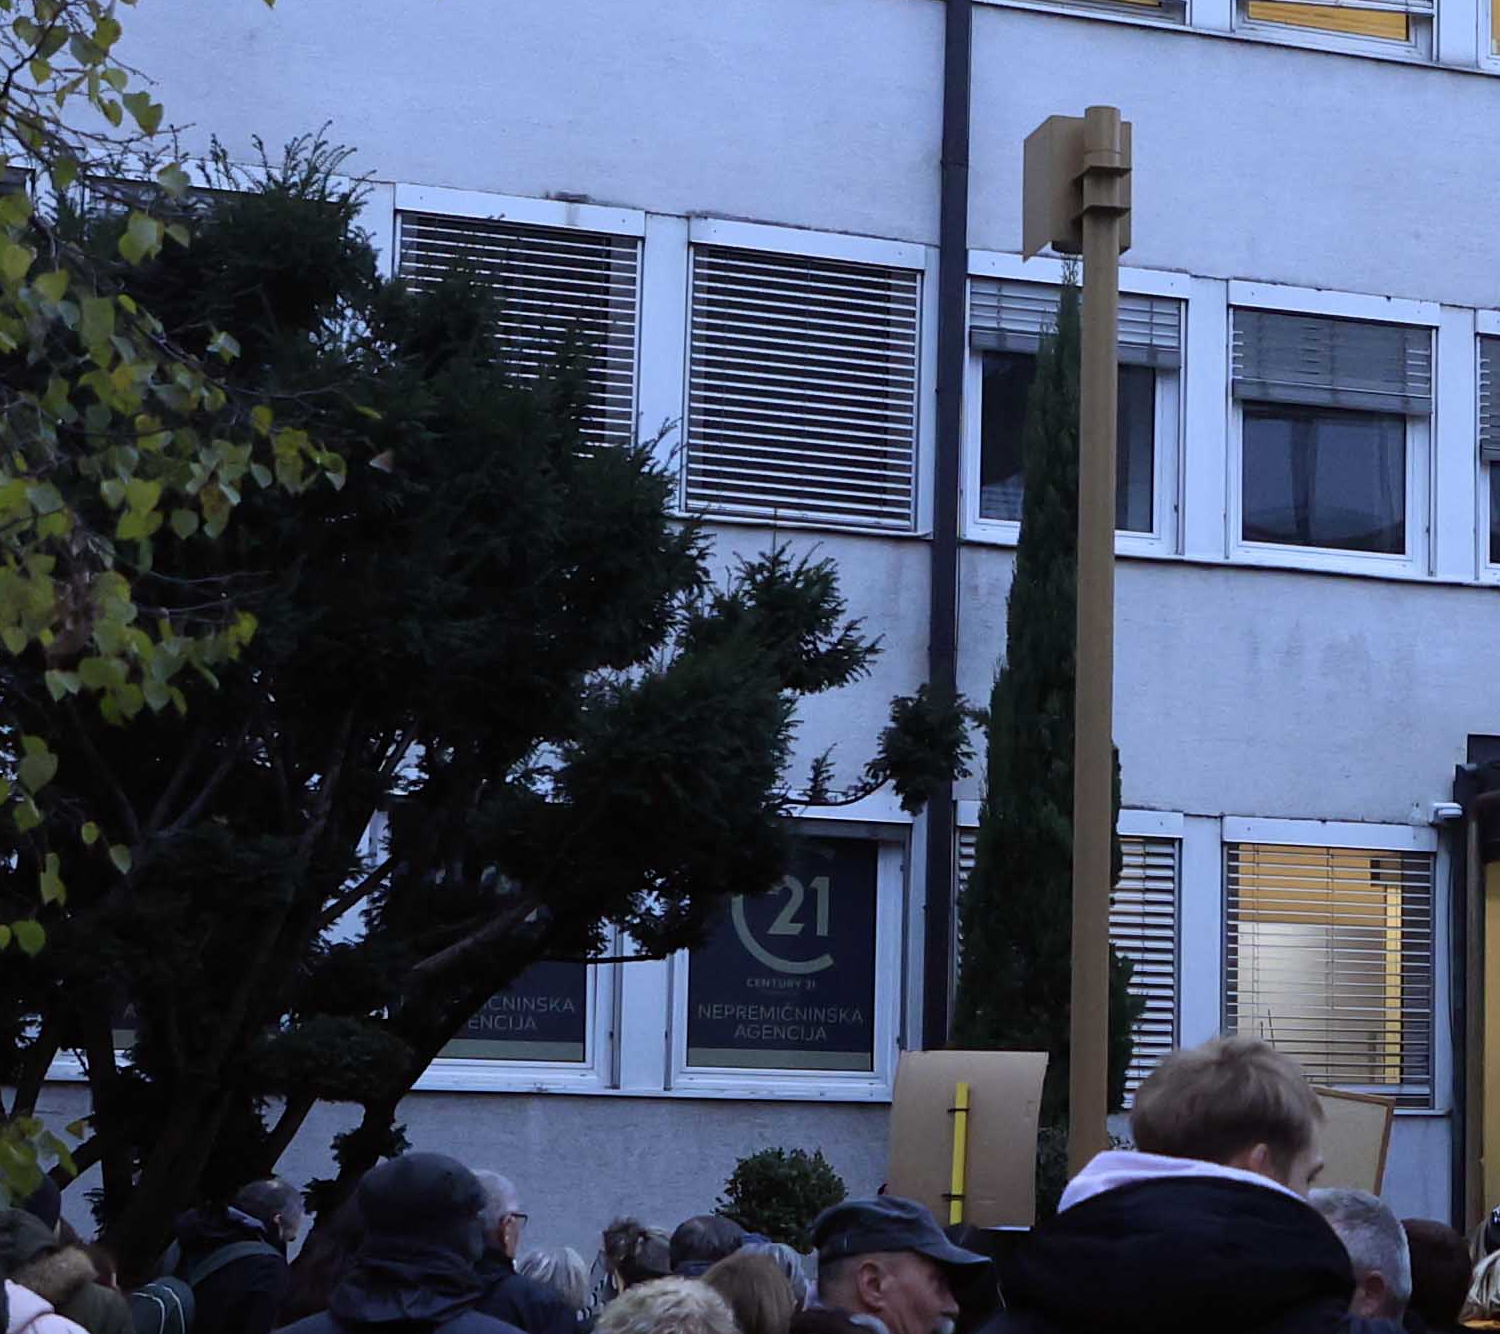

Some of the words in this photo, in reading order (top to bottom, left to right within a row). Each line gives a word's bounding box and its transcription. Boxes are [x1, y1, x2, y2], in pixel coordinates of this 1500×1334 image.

[697, 1000, 865, 1025] NEPREMIČNINSKA
[467, 1014, 539, 1031] ENCIJA
[733, 1023, 828, 1042] AGENCIJA
